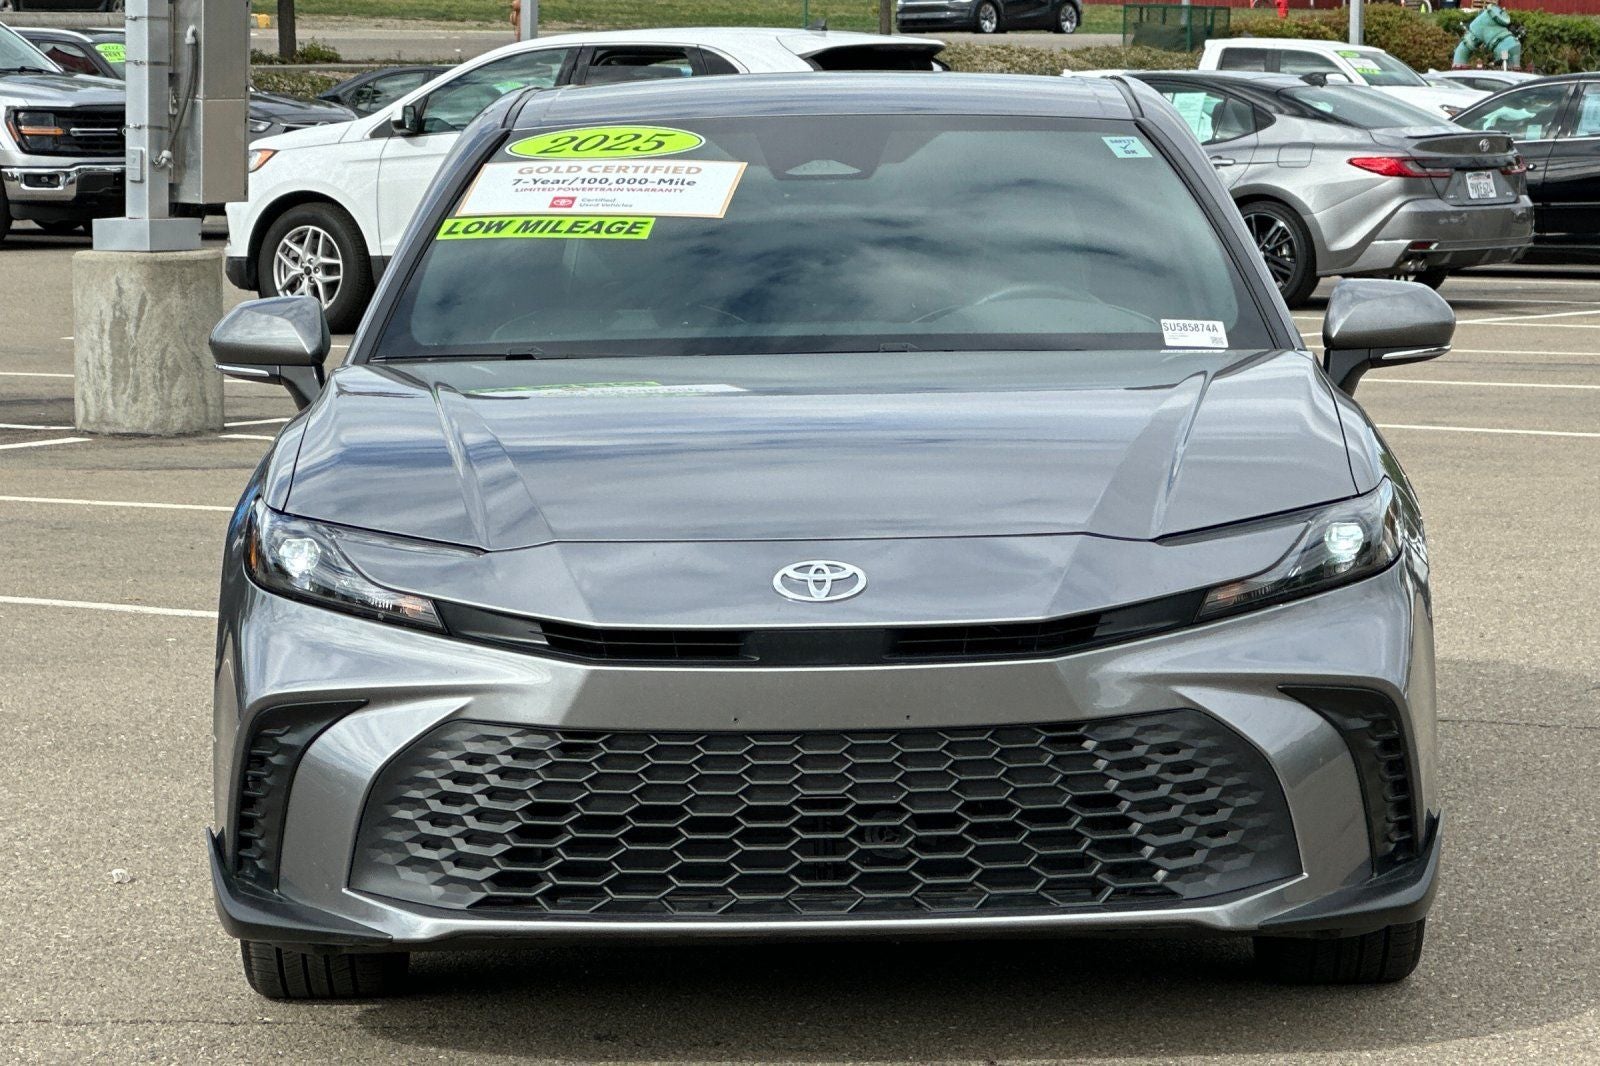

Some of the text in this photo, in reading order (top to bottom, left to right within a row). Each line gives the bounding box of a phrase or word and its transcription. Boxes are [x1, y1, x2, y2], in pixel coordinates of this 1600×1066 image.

[537, 133, 675, 154] 2025
[518, 165, 702, 175] GOLD CERTIFIED
[512, 177, 697, 187] 7-Year/100,000-Mile
[443, 220, 650, 235] LOW MILEAGE
[1163, 321, 1219, 332] SU585874A
